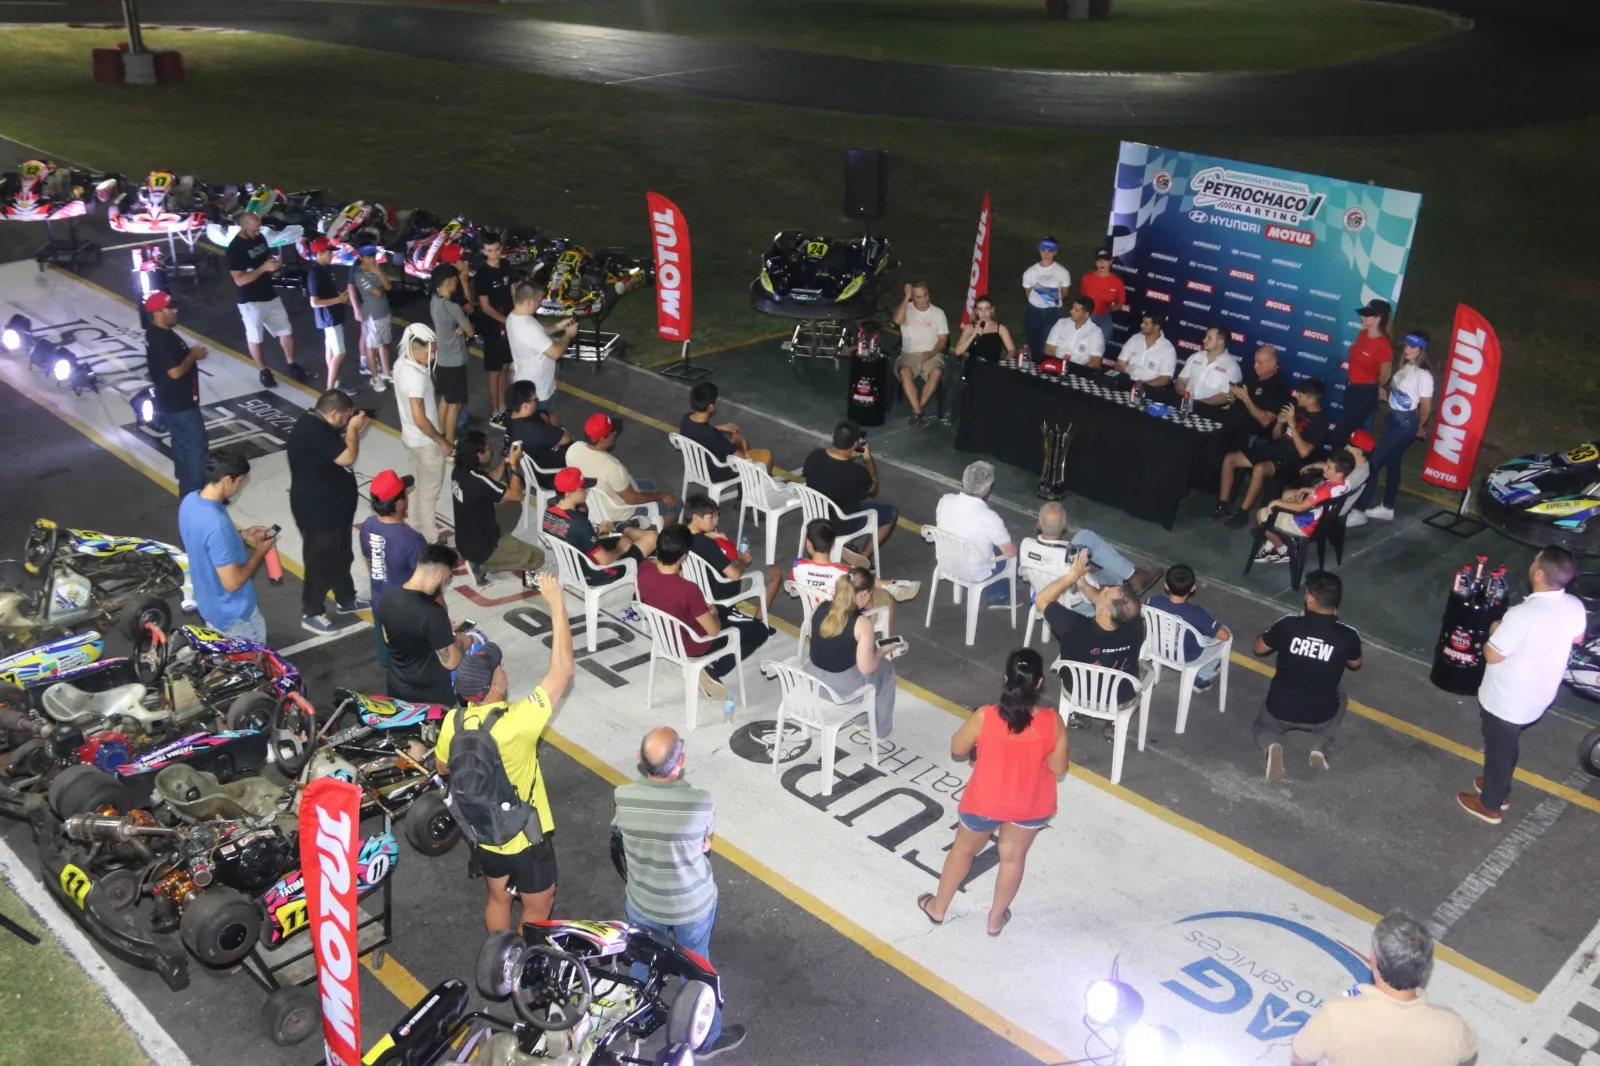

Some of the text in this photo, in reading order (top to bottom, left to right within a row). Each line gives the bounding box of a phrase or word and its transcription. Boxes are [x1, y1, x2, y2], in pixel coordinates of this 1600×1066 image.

[154, 176, 167, 187] 17
[1202, 181, 1307, 211] PETROCHACO
[1235, 204, 1298, 223] KARTING
[1210, 215, 1261, 234] HYUNDAI
[1267, 226, 1312, 245] MOTUL
[809, 243, 825, 255] 24
[653, 208, 682, 320] MOTUL
[1229, 269, 1255, 282] MOTUL
[1146, 290, 1170, 301] MOTUL
[1188, 281, 1212, 293] MOTUL
[1265, 300, 1292, 312] MOTUL
[1303, 329, 1330, 342] MOTUL
[1433, 328, 1487, 465] MOTUL
[1424, 466, 1458, 484] MOTUL
[1289, 637, 1334, 662] CREW
[1443, 646, 1473, 662] MOTUL
[373, 859, 385, 881] 11
[65, 871, 85, 898] 11
[315, 804, 356, 1051] MOTUL
[1185, 929, 1294, 993] services
